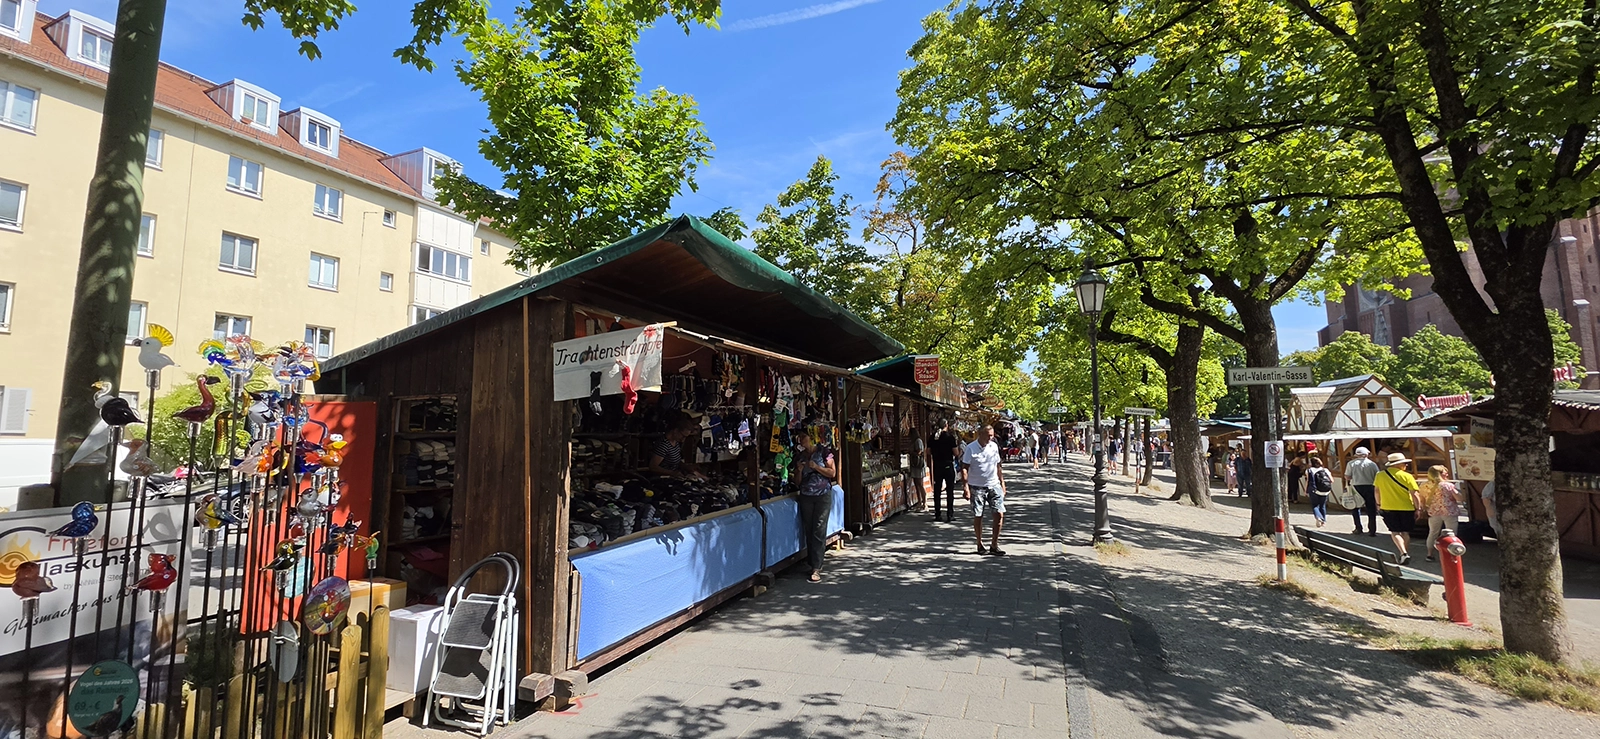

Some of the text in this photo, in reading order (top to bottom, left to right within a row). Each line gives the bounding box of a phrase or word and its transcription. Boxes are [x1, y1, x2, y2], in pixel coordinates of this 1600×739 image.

[555, 338, 662, 367] Trachtenstrümpfe
[1233, 370, 1308, 382] Karl-Valentin-Gasse
[1472, 419, 1494, 430] Pomm
[38, 548, 141, 577] laskunst
